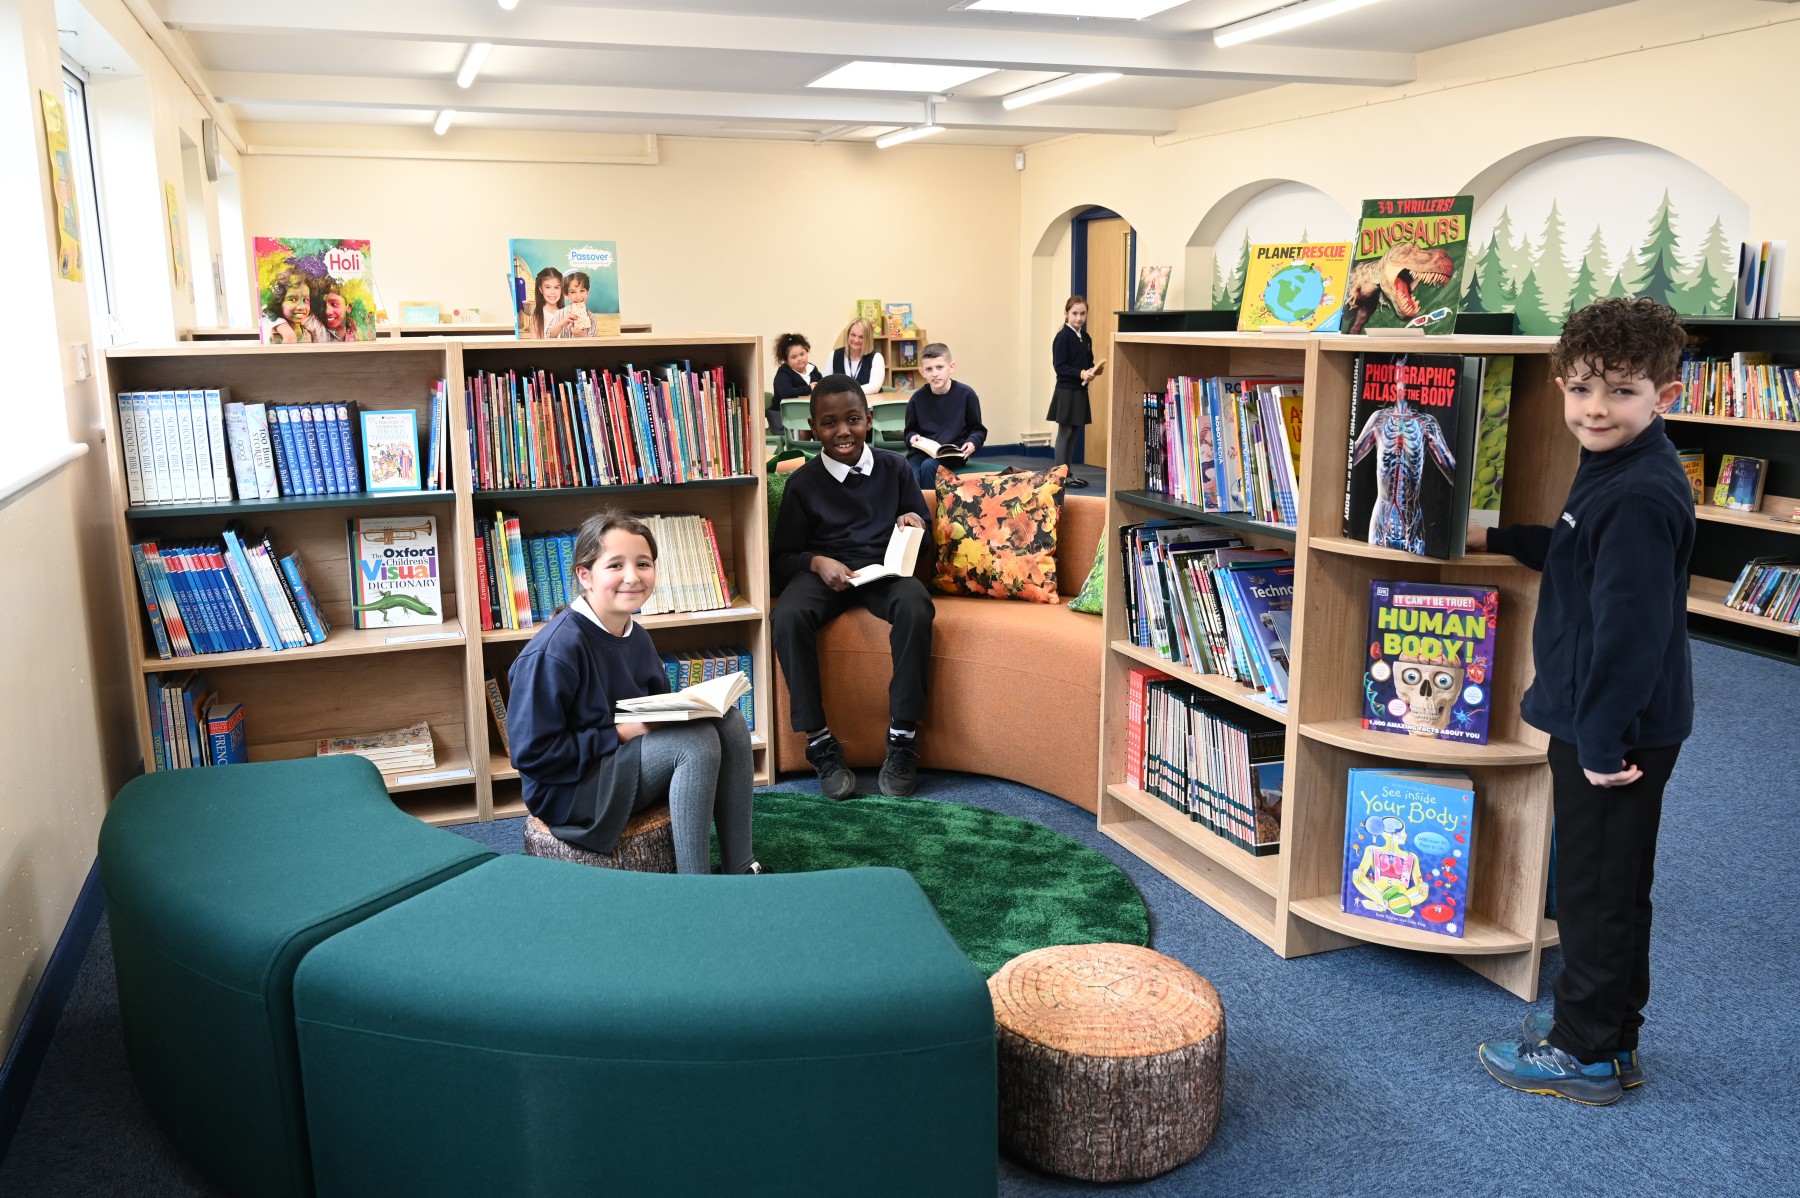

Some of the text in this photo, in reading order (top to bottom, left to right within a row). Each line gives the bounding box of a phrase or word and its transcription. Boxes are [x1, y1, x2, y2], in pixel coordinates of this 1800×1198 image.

[1378, 198, 1456, 214] 3-D THRILLERS!
[1362, 216, 1460, 253] DINOSAURS
[330, 254, 359, 270] Holi
[572, 252, 608, 260] Passover
[1366, 364, 1456, 387] PHOTOGRAPHIC
[1349, 359, 1359, 436] PHOTOGRAPHIC
[1363, 382, 1454, 407] ATLAS OF THE BODY
[252, 433, 263, 466] STORIES
[285, 434, 295, 467] Children's
[319, 433, 328, 466] Children's
[330, 433, 341, 465] Children's
[342, 432, 351, 465] Children's
[1214, 416, 1223, 464] ROBOTPEDIA
[129, 457, 138, 475] BIBLE
[143, 456, 152, 474] BIBLE
[157, 455, 166, 473] BIBLE
[171, 455, 180, 473] BIBLE
[185, 454, 194, 472] BIBLE
[263, 448, 271, 469] BIBLE
[273, 434, 288, 486] Children's Bible
[297, 434, 311, 485] Children's Bible
[307, 433, 322, 485] Children's Bible
[383, 547, 435, 558] Oxford
[386, 558, 428, 566] Children's
[533, 541, 546, 581] OXFORD
[547, 541, 560, 581] OXFORD
[359, 557, 436, 580] Visual
[368, 579, 436, 590] DICTIONARY
[200, 589, 219, 632] FIRST DICTIONARY
[206, 589, 226, 631] FIRST DICTIONARY
[214, 588, 234, 631] FIRST DICTIONARY
[222, 588, 242, 630] FIRST DICTIONARY
[302, 602, 316, 632] Encyclopedia
[1406, 597, 1431, 605] CAN'T
[1446, 599, 1472, 607] TRUE!
[185, 605, 199, 633] DICTIONARY
[199, 604, 213, 632] DICTIONARY
[1378, 607, 1486, 639] HUMAN
[1384, 633, 1474, 663] BODY!
[487, 682, 506, 719] OXFORD
[1369, 719, 1385, 727] 1,000
[1387, 721, 1417, 731] AMAZING
[1418, 726, 1439, 734] FACTS
[1465, 731, 1480, 739] YOU
[154, 736, 162, 753] TOUT
[1382, 786, 1437, 804] See inside
[1361, 791, 1459, 831] Your Body
